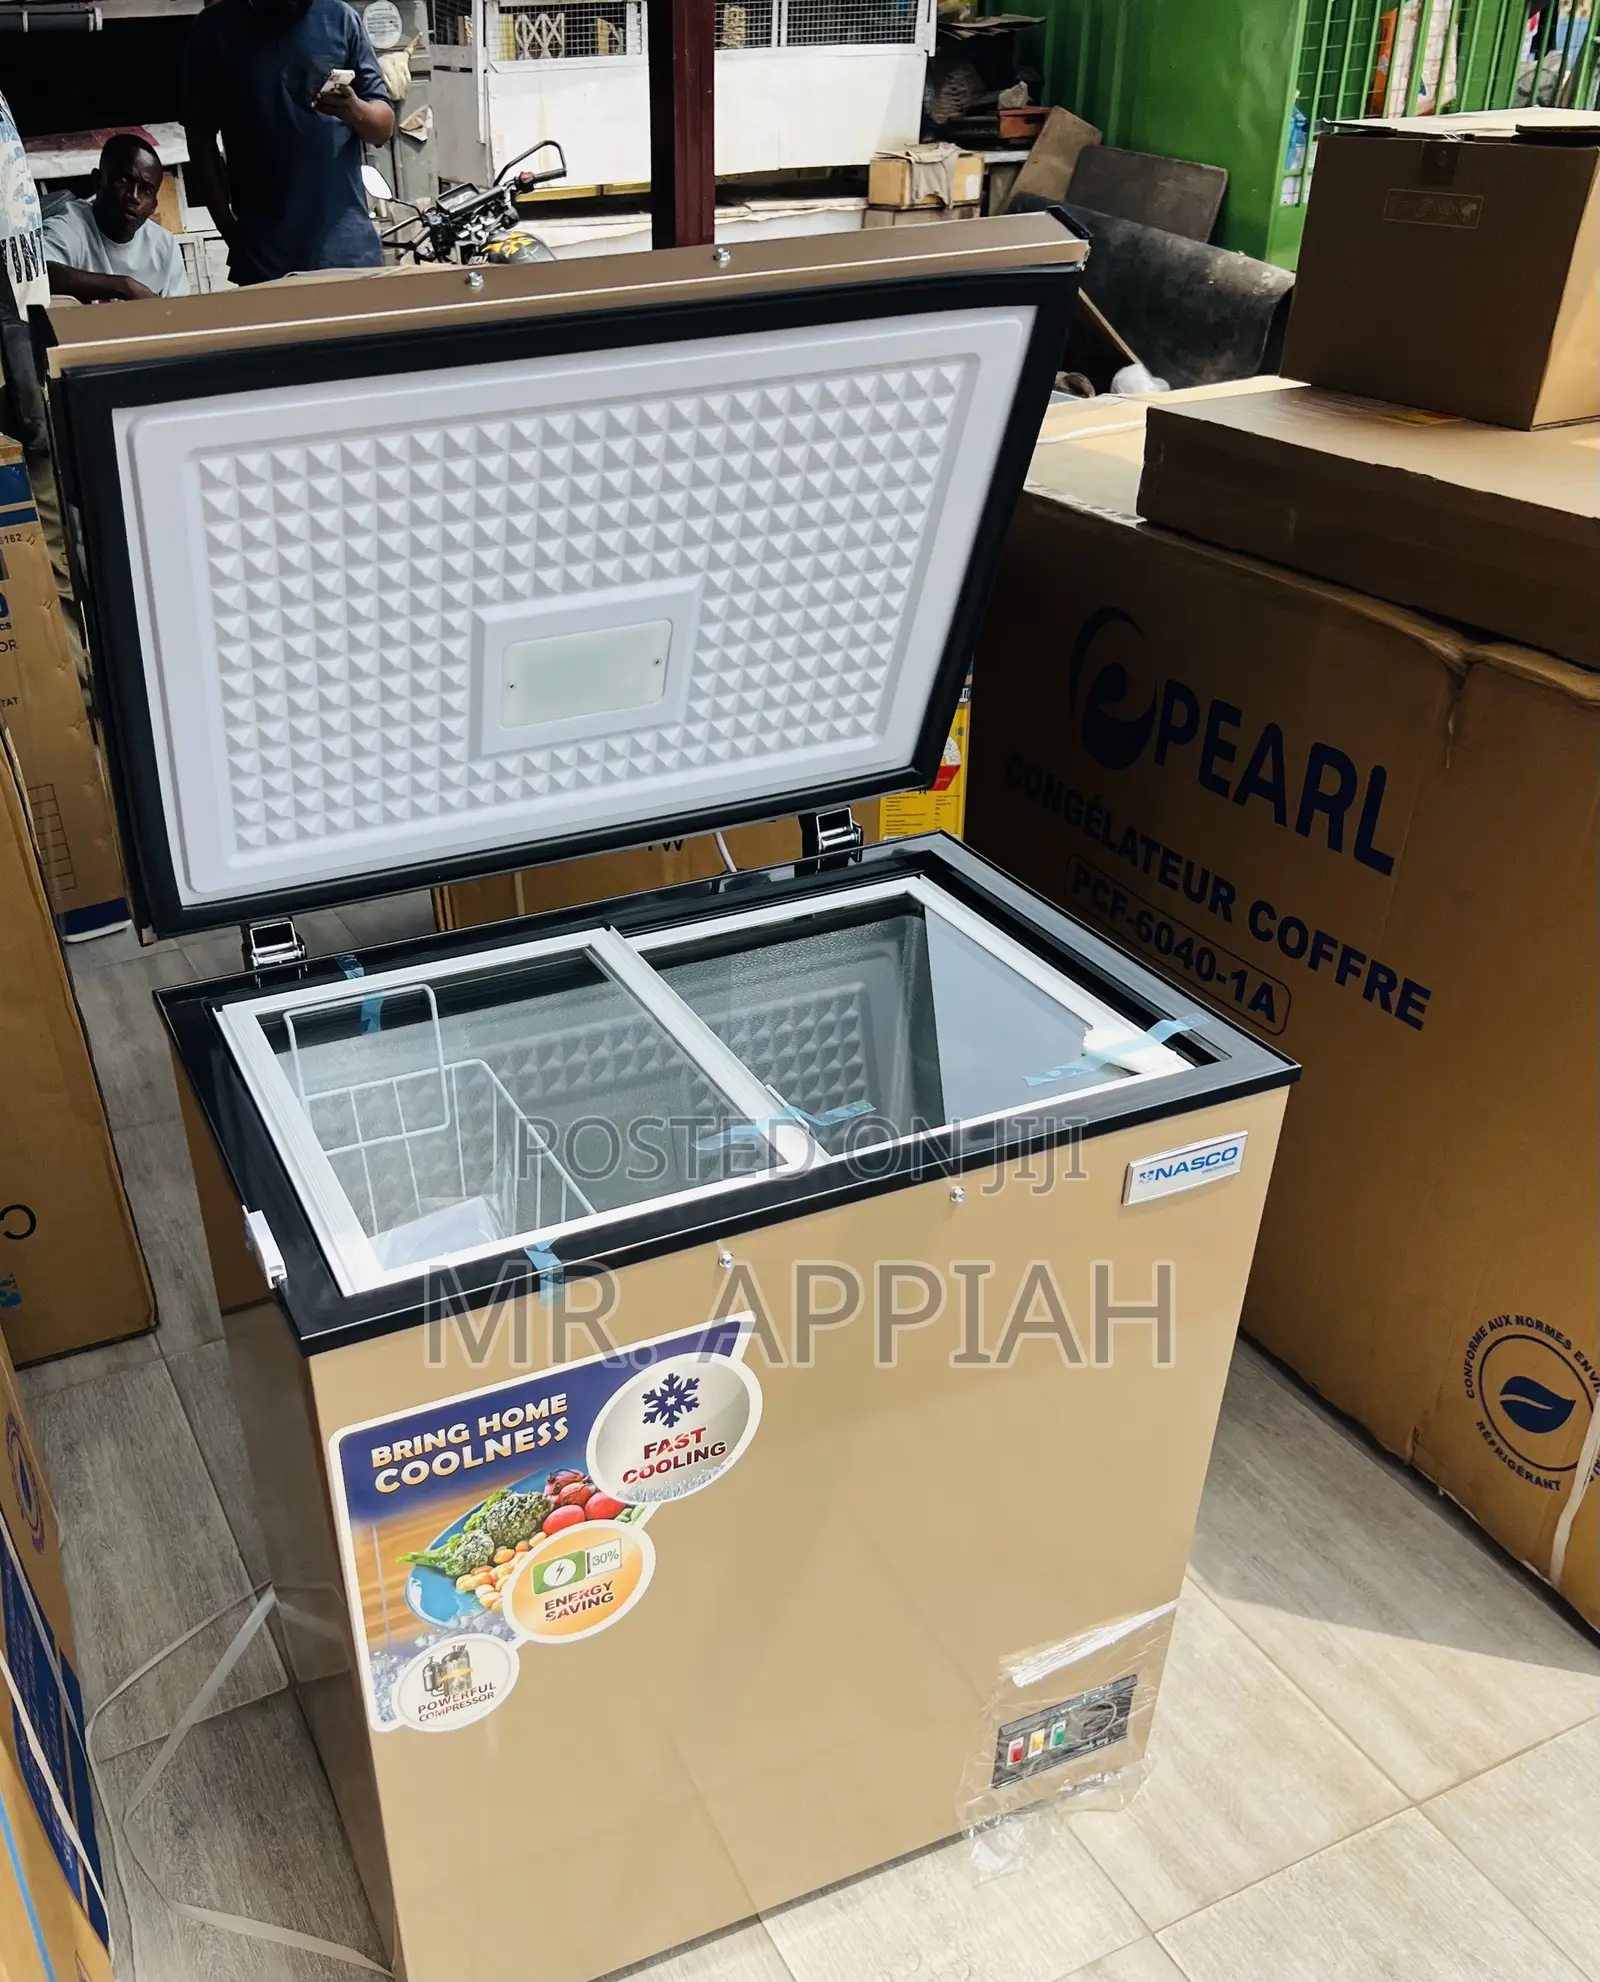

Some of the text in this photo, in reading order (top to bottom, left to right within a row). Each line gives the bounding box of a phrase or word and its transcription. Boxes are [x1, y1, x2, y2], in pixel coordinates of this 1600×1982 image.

[1153, 678, 1395, 877] PEARL
[1006, 754, 1432, 1031] CONGÉLATEUR COFFRE
[1071, 864, 1277, 1024] PCF-6040-1A
[1154, 1146, 1239, 1181] NASCO
[1463, 1325, 1489, 1400] CONFORME
[1487, 1314, 1513, 1333] AUX
[1515, 1314, 1573, 1351] NORMES
[371, 1392, 568, 1468] BRING HOME
[643, 1426, 707, 1460] FAST
[374, 1416, 569, 1494] COOLNESS
[622, 1441, 726, 1485] COOLING
[1475, 1420, 1561, 1492] RÉFRIGÉRANT
[591, 1548, 620, 1567] 30%
[544, 1579, 614, 1611] ENERGY
[545, 1591, 614, 1623] SAVING
[418, 1681, 497, 1715] POWERFUL
[419, 1691, 495, 1722] COMPRESSOR
